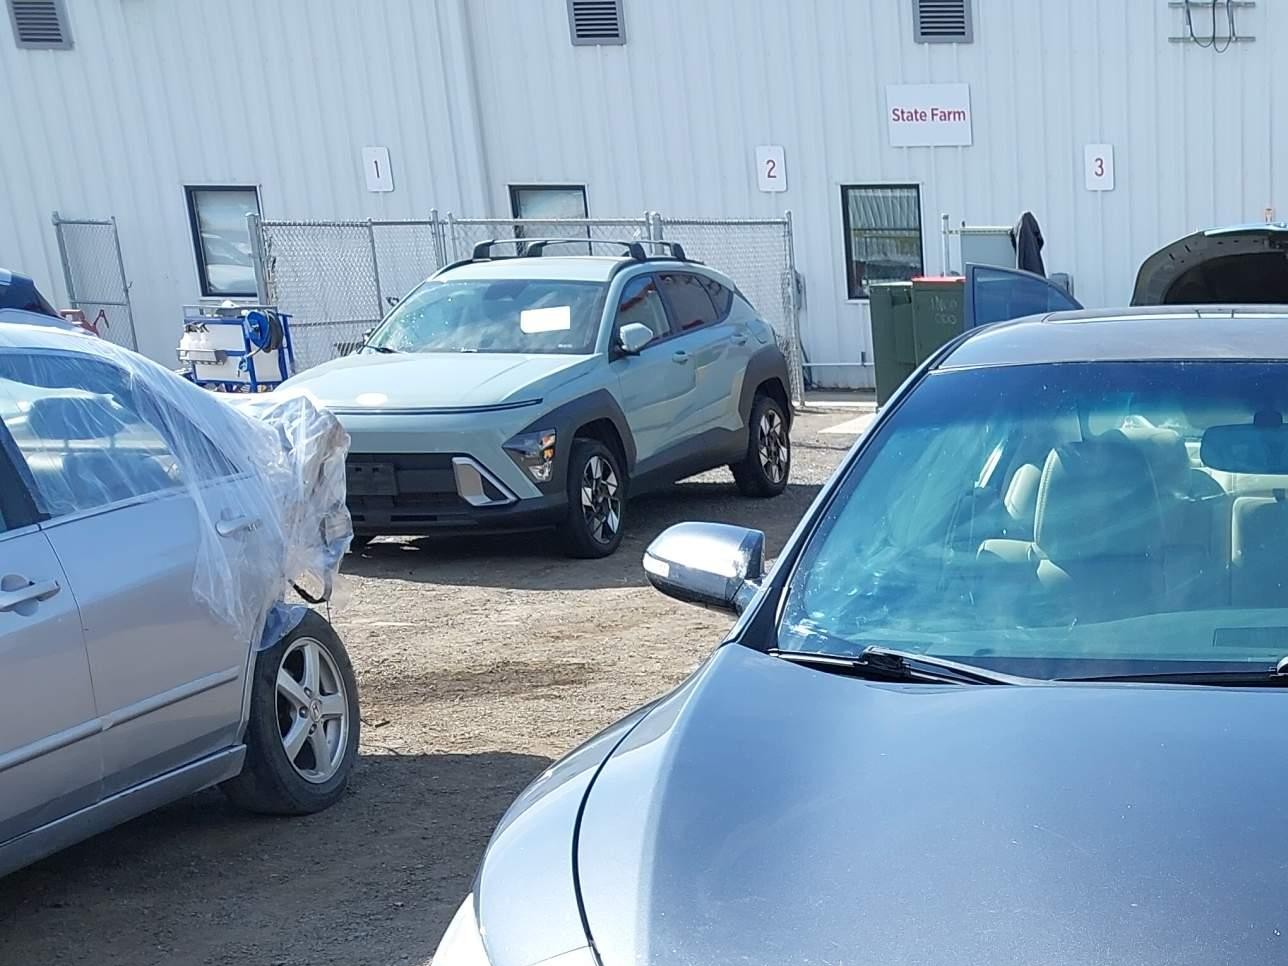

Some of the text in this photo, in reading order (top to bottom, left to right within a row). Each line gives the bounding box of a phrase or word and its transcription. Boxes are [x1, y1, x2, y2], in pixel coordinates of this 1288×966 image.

[892, 107, 966, 122] State Farm
[373, 160, 380, 178] 1
[766, 159, 777, 179] 2
[1094, 157, 1104, 177] 3
